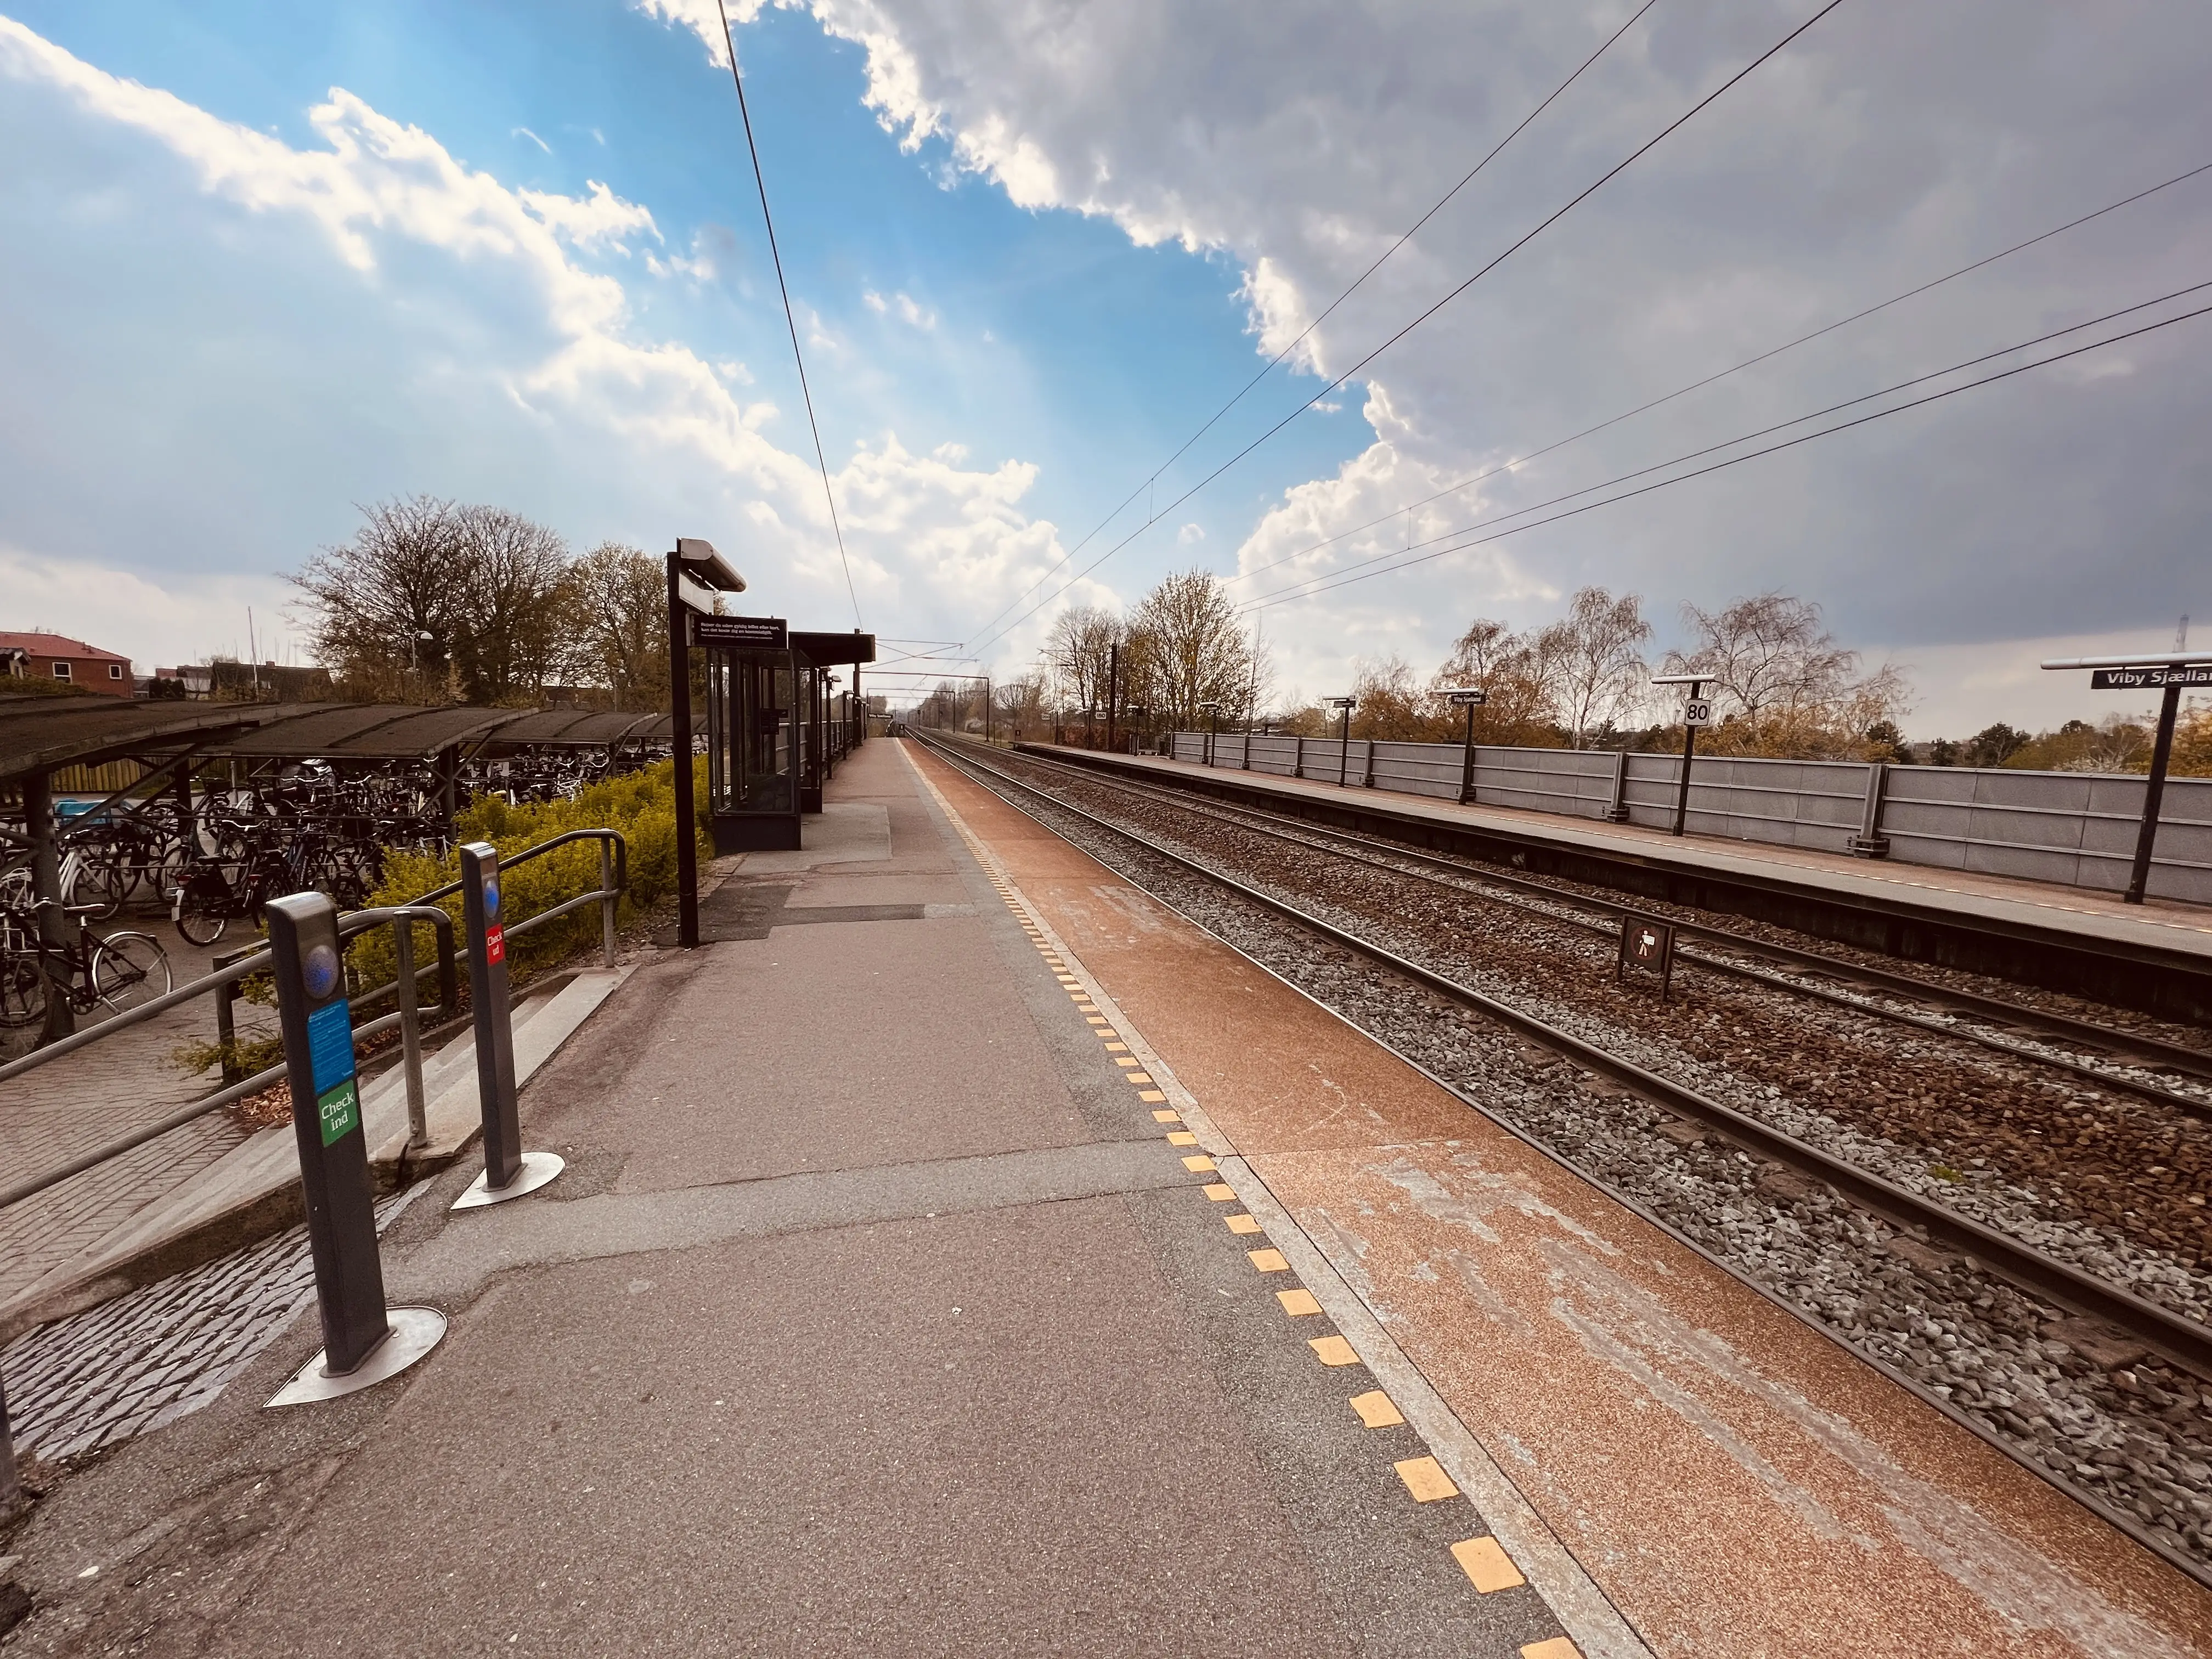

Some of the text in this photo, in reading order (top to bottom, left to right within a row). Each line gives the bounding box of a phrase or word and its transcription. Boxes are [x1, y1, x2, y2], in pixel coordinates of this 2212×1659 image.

[2107, 672, 2146, 685] Viby
[1687, 704, 1708, 720] 80
[487, 931, 503, 946] Check
[321, 1092, 354, 1119] Check
[331, 1110, 348, 1131] ind
